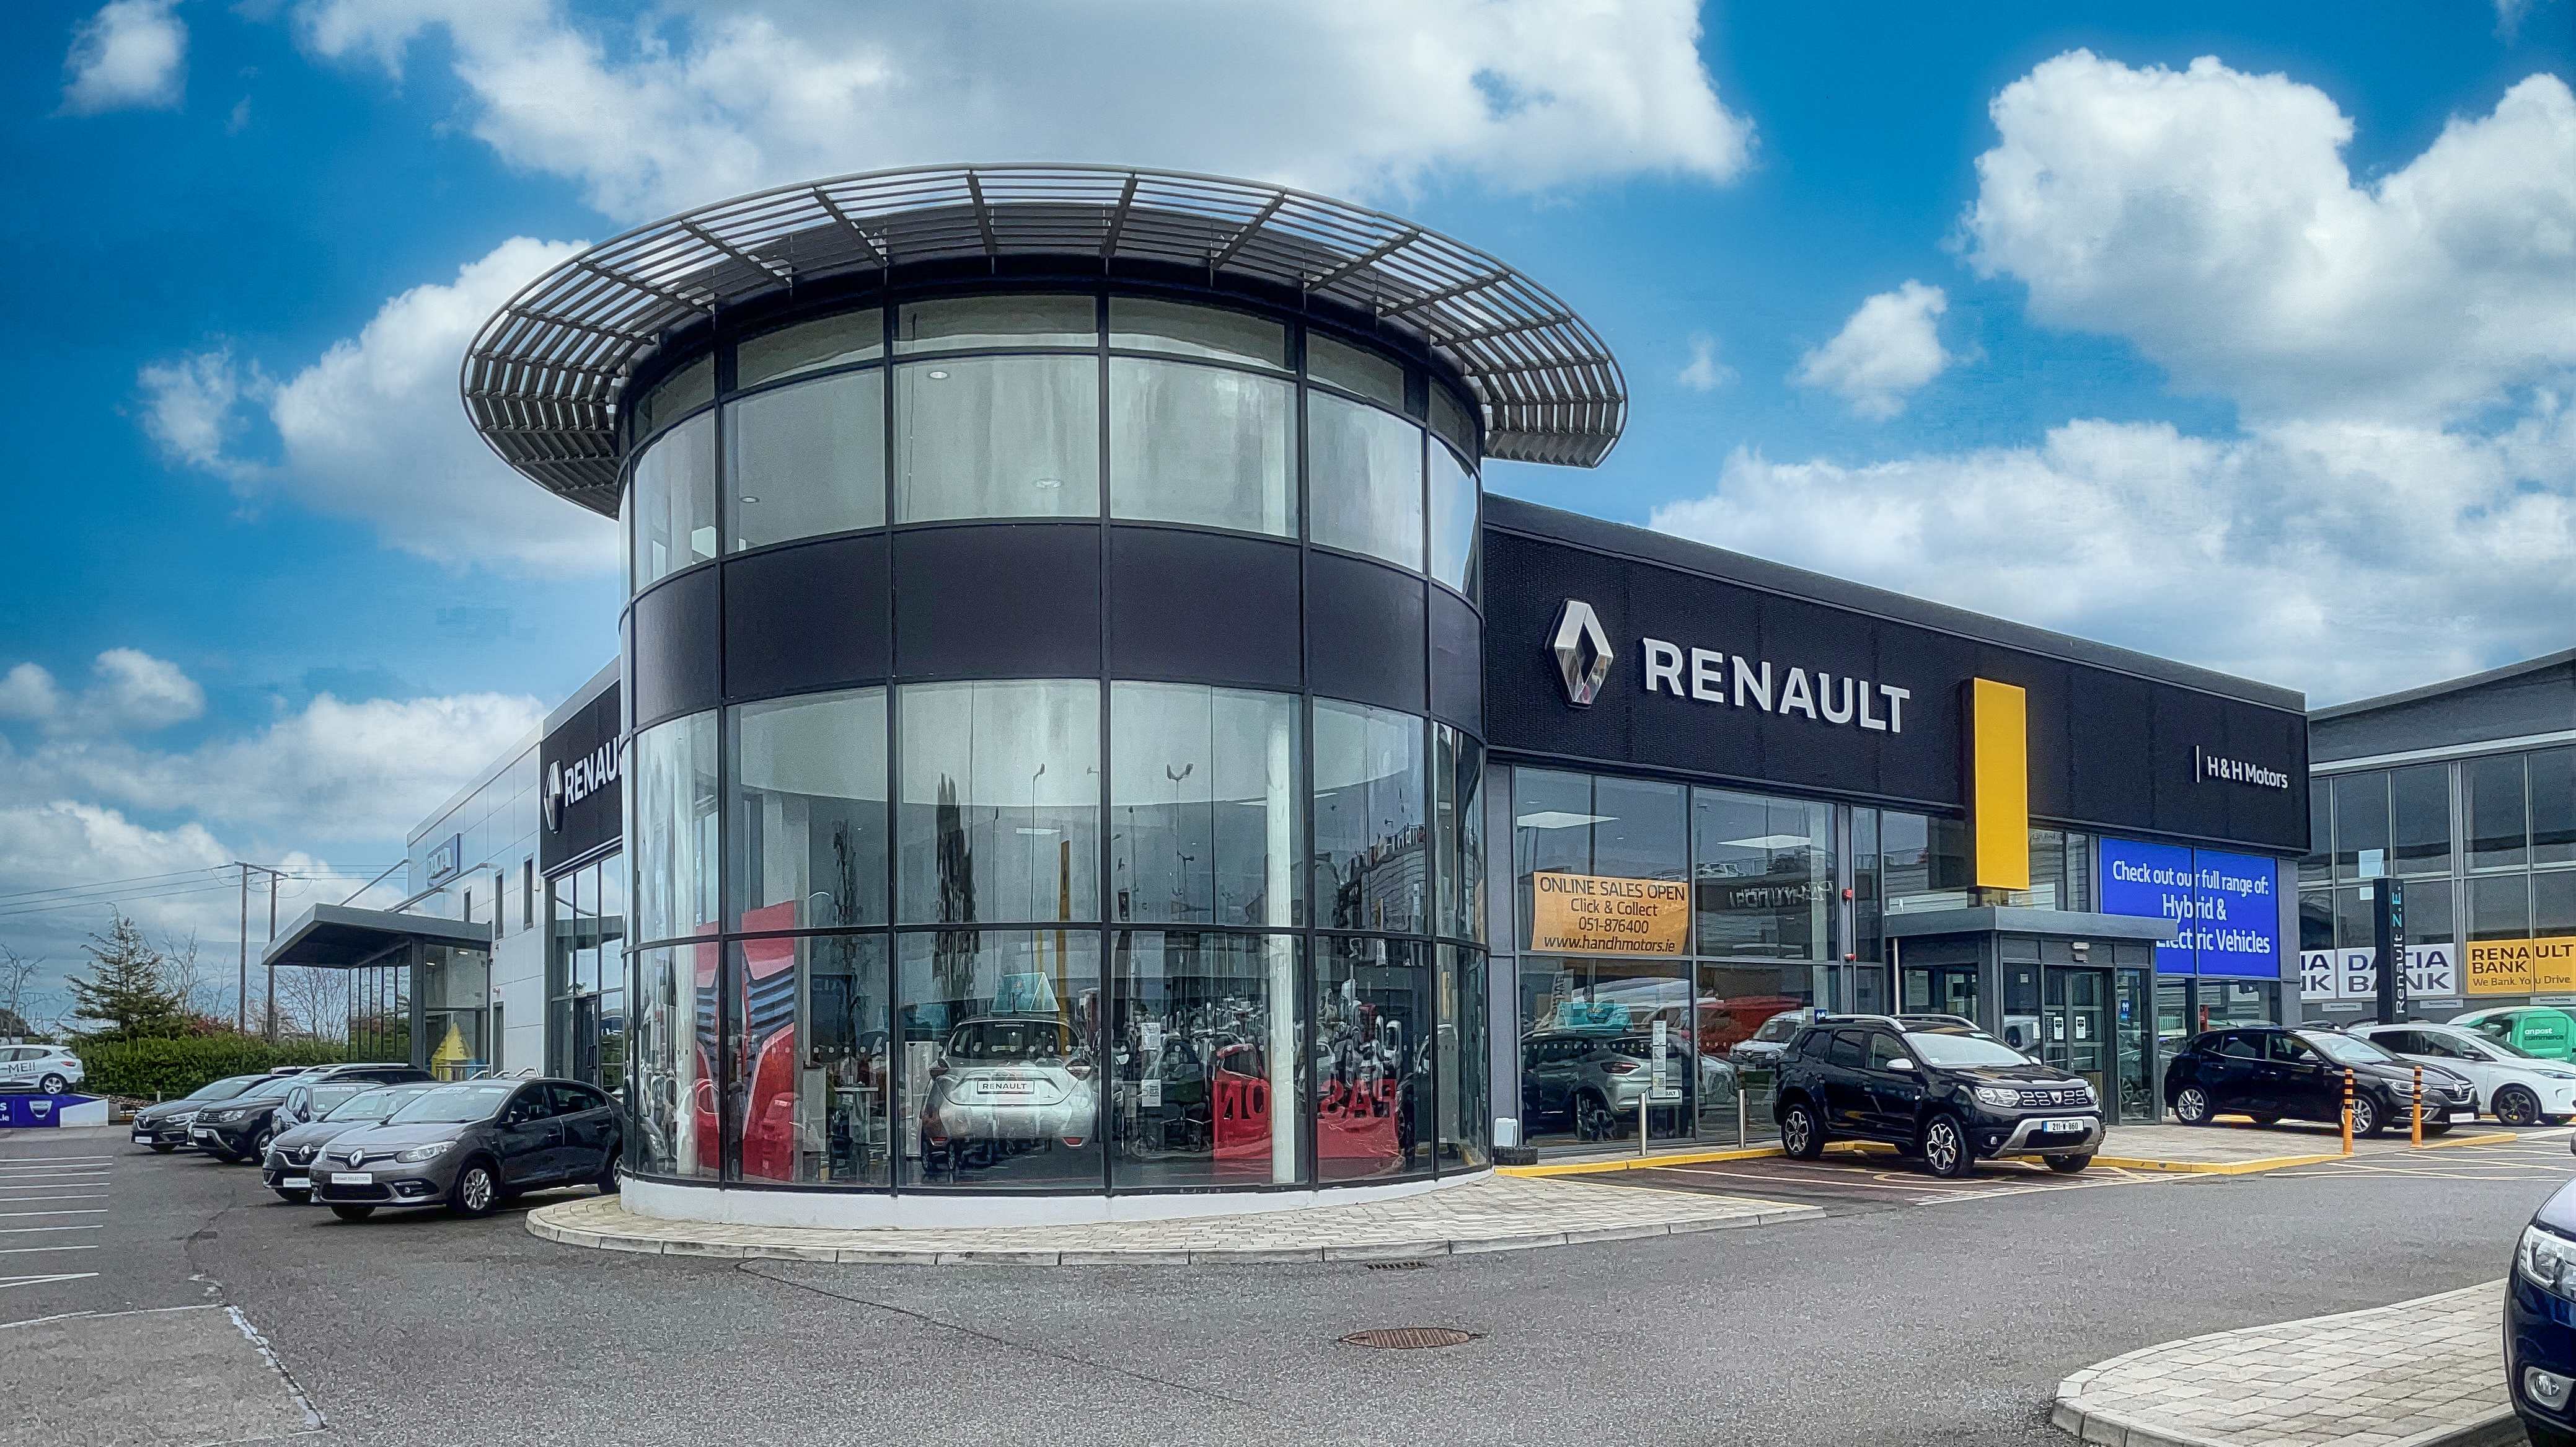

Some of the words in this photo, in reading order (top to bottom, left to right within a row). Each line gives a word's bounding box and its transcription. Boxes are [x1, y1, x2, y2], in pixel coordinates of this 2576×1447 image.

[1643, 638, 1910, 733] RENAULT
[2244, 763, 2288, 789] Motors
[1540, 876, 1595, 895] ONLINE
[1600, 881, 1643, 898] SALES
[1647, 884, 1685, 901] OPEN
[2113, 861, 2151, 883] Check
[2153, 867, 2175, 885] out
[2176, 871, 2199, 887] our
[2202, 869, 2220, 890] full
[2221, 875, 2252, 897] range
[2254, 876, 2269, 895] of:
[1571, 898, 1600, 914] Click
[1604, 900, 1613, 911] &
[1617, 901, 1658, 917] Collect
[2162, 893, 2214, 924] Hybrid
[2217, 898, 2227, 921] &
[2392, 886, 2402, 927] Z.E.
[1578, 916, 1649, 934] 051-876400
[1544, 935, 1675, 952] www.handhmotors.ie
[2216, 929, 2270, 954] Vehicles
[2472, 944, 2574, 960] RENAULT
[2393, 934, 2406, 1014] Renault
[2472, 961, 2528, 974] BANK
[2491, 977, 2517, 986] Bank.
[2544, 975, 2571, 984] Drive
